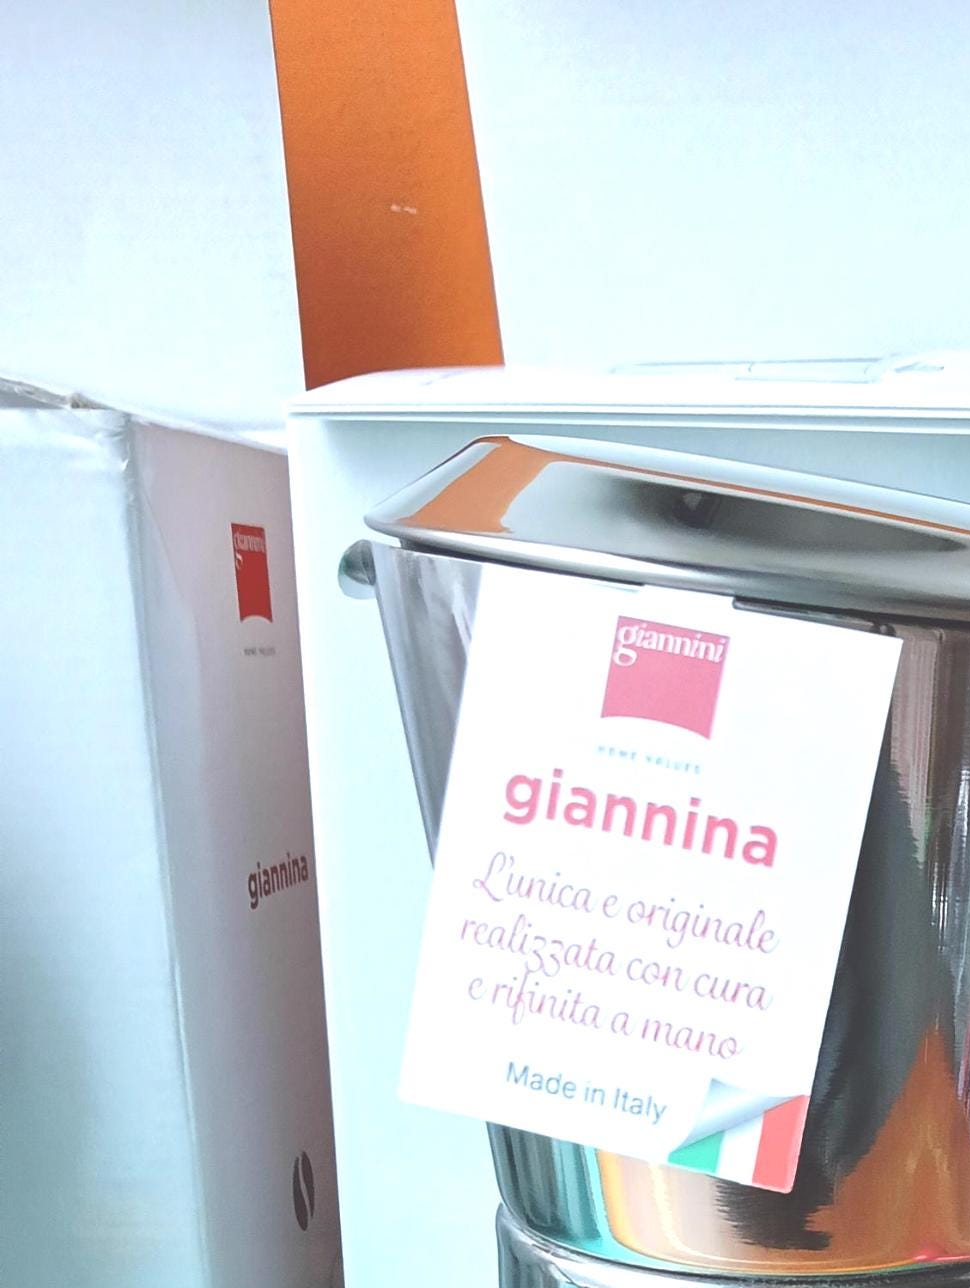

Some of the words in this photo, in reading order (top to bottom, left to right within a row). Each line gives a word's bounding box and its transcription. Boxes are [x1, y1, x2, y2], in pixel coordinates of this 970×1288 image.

[612, 622, 728, 668] giannini
[502, 767, 779, 868] giannina
[247, 850, 310, 911] giannina
[472, 851, 598, 914] L'unica
[602, 894, 622, 919] e
[627, 897, 780, 955] originale
[460, 913, 622, 978] realizzata
[626, 957, 689, 992] con
[693, 972, 774, 1011] cura
[467, 976, 487, 1001] e
[491, 969, 607, 1030] rifinita
[610, 1011, 635, 1037] a
[640, 1017, 744, 1060] mano
[505, 1061, 578, 1100] Made
[584, 1080, 606, 1106] in
[613, 1087, 668, 1126] Italy
